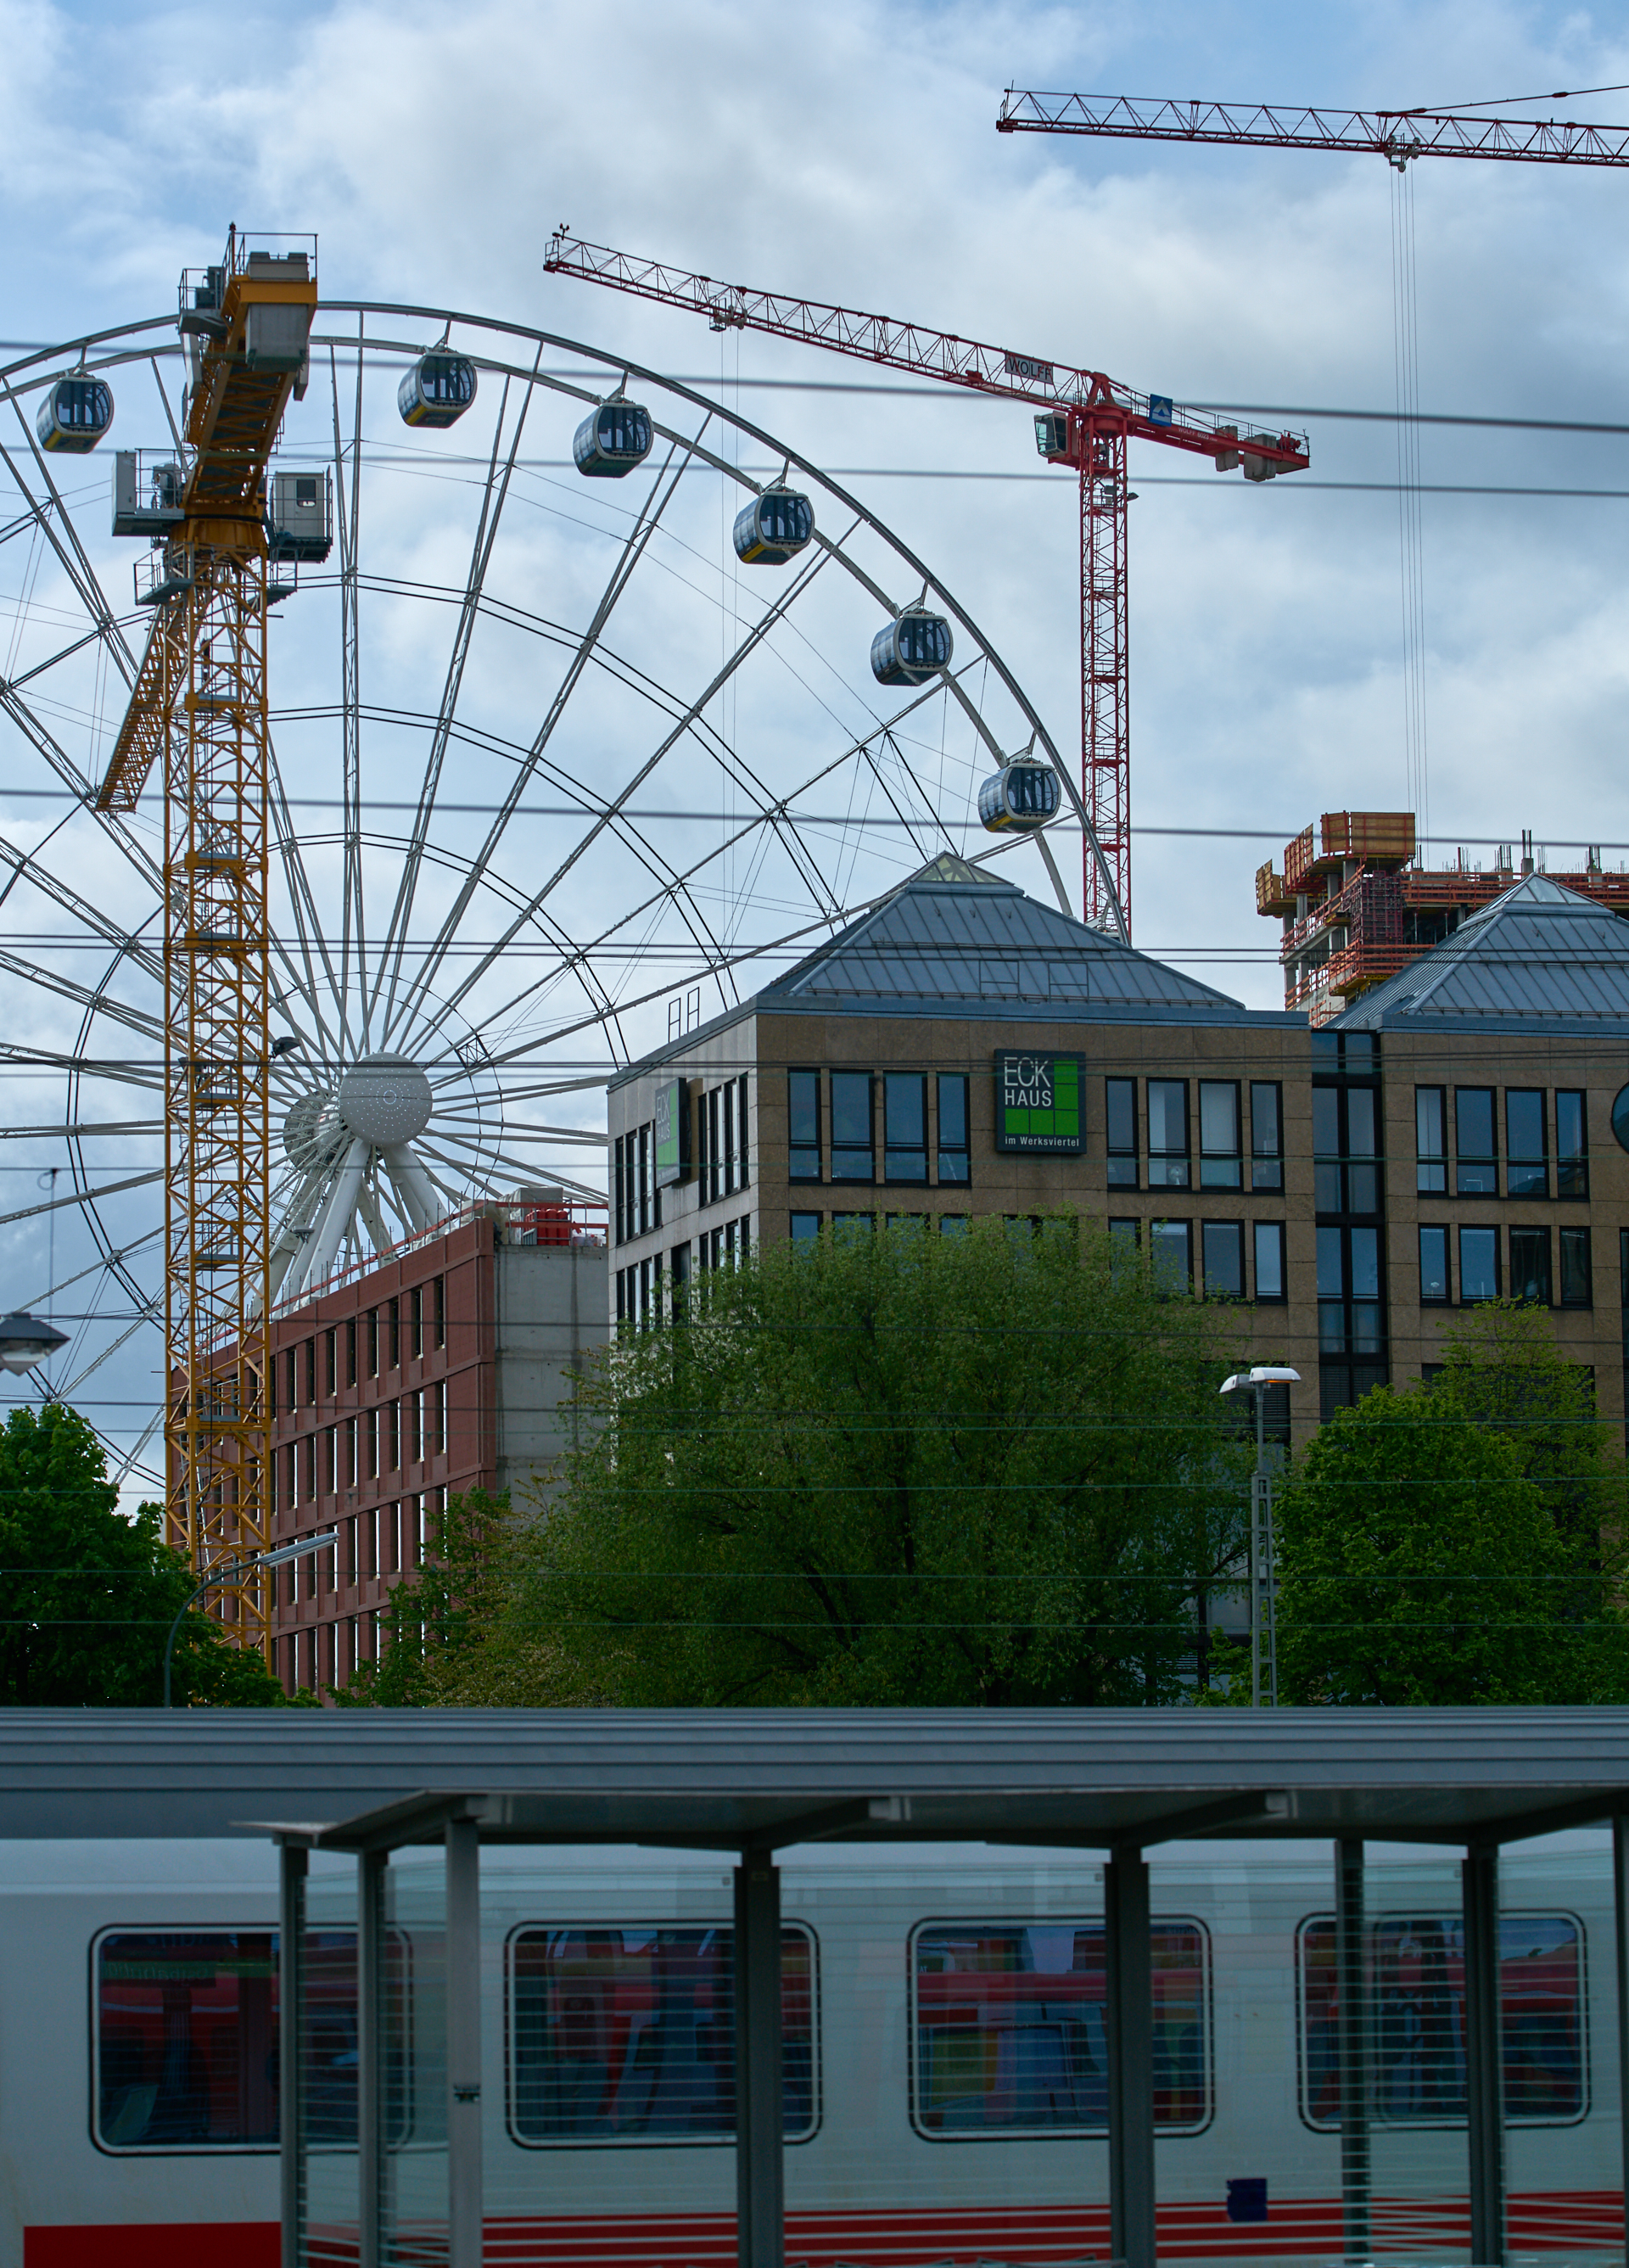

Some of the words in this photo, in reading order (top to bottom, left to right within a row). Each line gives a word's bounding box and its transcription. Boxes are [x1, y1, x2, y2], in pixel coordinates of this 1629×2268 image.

[1009, 357, 1052, 380] WOLFF
[1004, 1056, 1051, 1088] ECK
[657, 1090, 670, 1125] ECK
[1005, 1089, 1052, 1107] HAUS
[1005, 1135, 1016, 1145] im
[1019, 1136, 1079, 1147] Werksviertel
